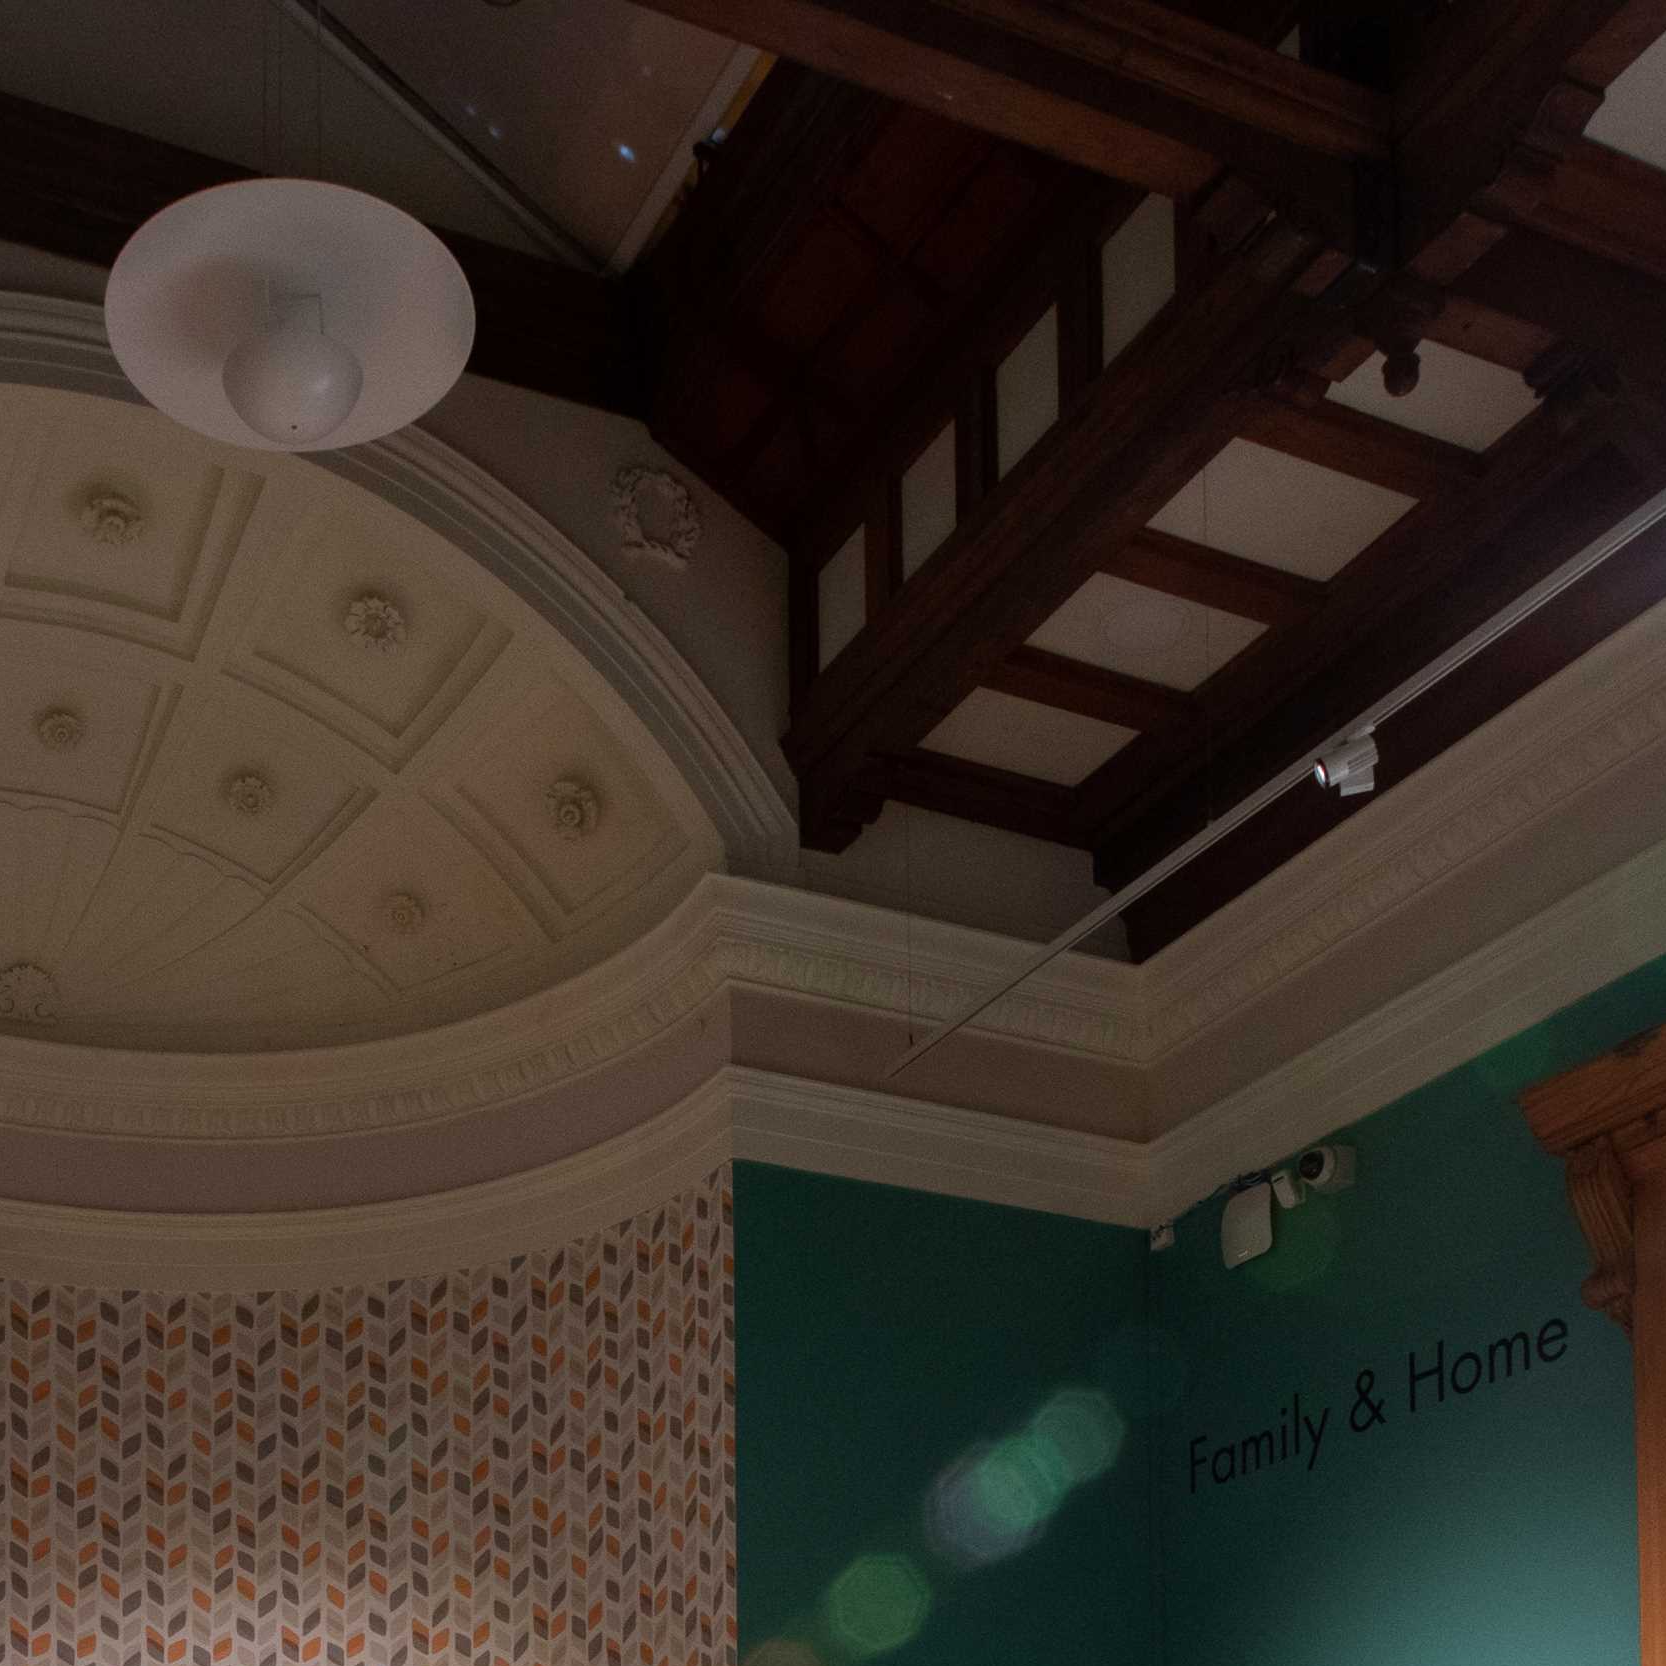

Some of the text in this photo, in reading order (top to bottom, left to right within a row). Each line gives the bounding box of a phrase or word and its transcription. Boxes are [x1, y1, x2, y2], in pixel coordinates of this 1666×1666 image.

[1190, 1317, 1569, 1494] Family & Home
